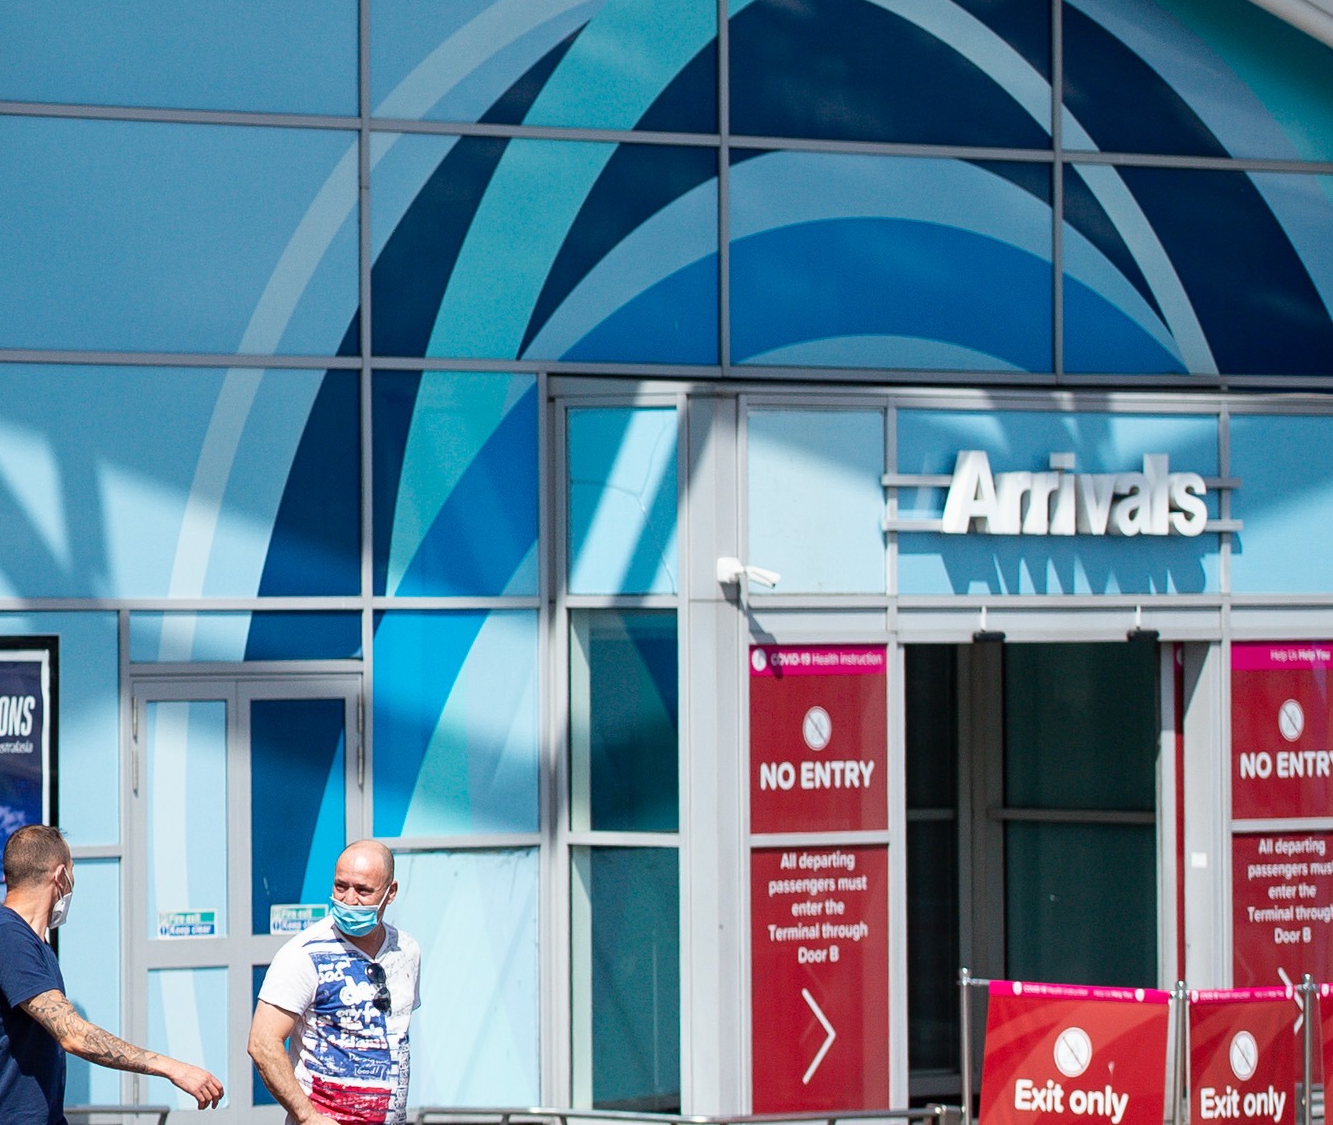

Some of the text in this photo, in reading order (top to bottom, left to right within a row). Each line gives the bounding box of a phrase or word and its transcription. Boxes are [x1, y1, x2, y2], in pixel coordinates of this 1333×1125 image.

[942, 449, 1210, 537] Arrivals
[771, 652, 882, 666] COVID-19 Health instruction
[760, 760, 875, 790] NO ENTRY
[1240, 752, 1272, 779] NO
[1258, 838, 1326, 857] All departing
[780, 851, 855, 871] All departing
[1248, 863, 1308, 880] passengers
[768, 875, 867, 897] passengers must
[1268, 883, 1317, 899] enter the
[791, 899, 845, 917] enter the
[1247, 905, 1294, 922] Terminal
[768, 921, 868, 941] Terminal through
[1274, 927, 1311, 944] Door B
[798, 945, 839, 964] Door B
[1014, 1079, 1129, 1124] Exit only
[1200, 1085, 1286, 1123] Exit only
